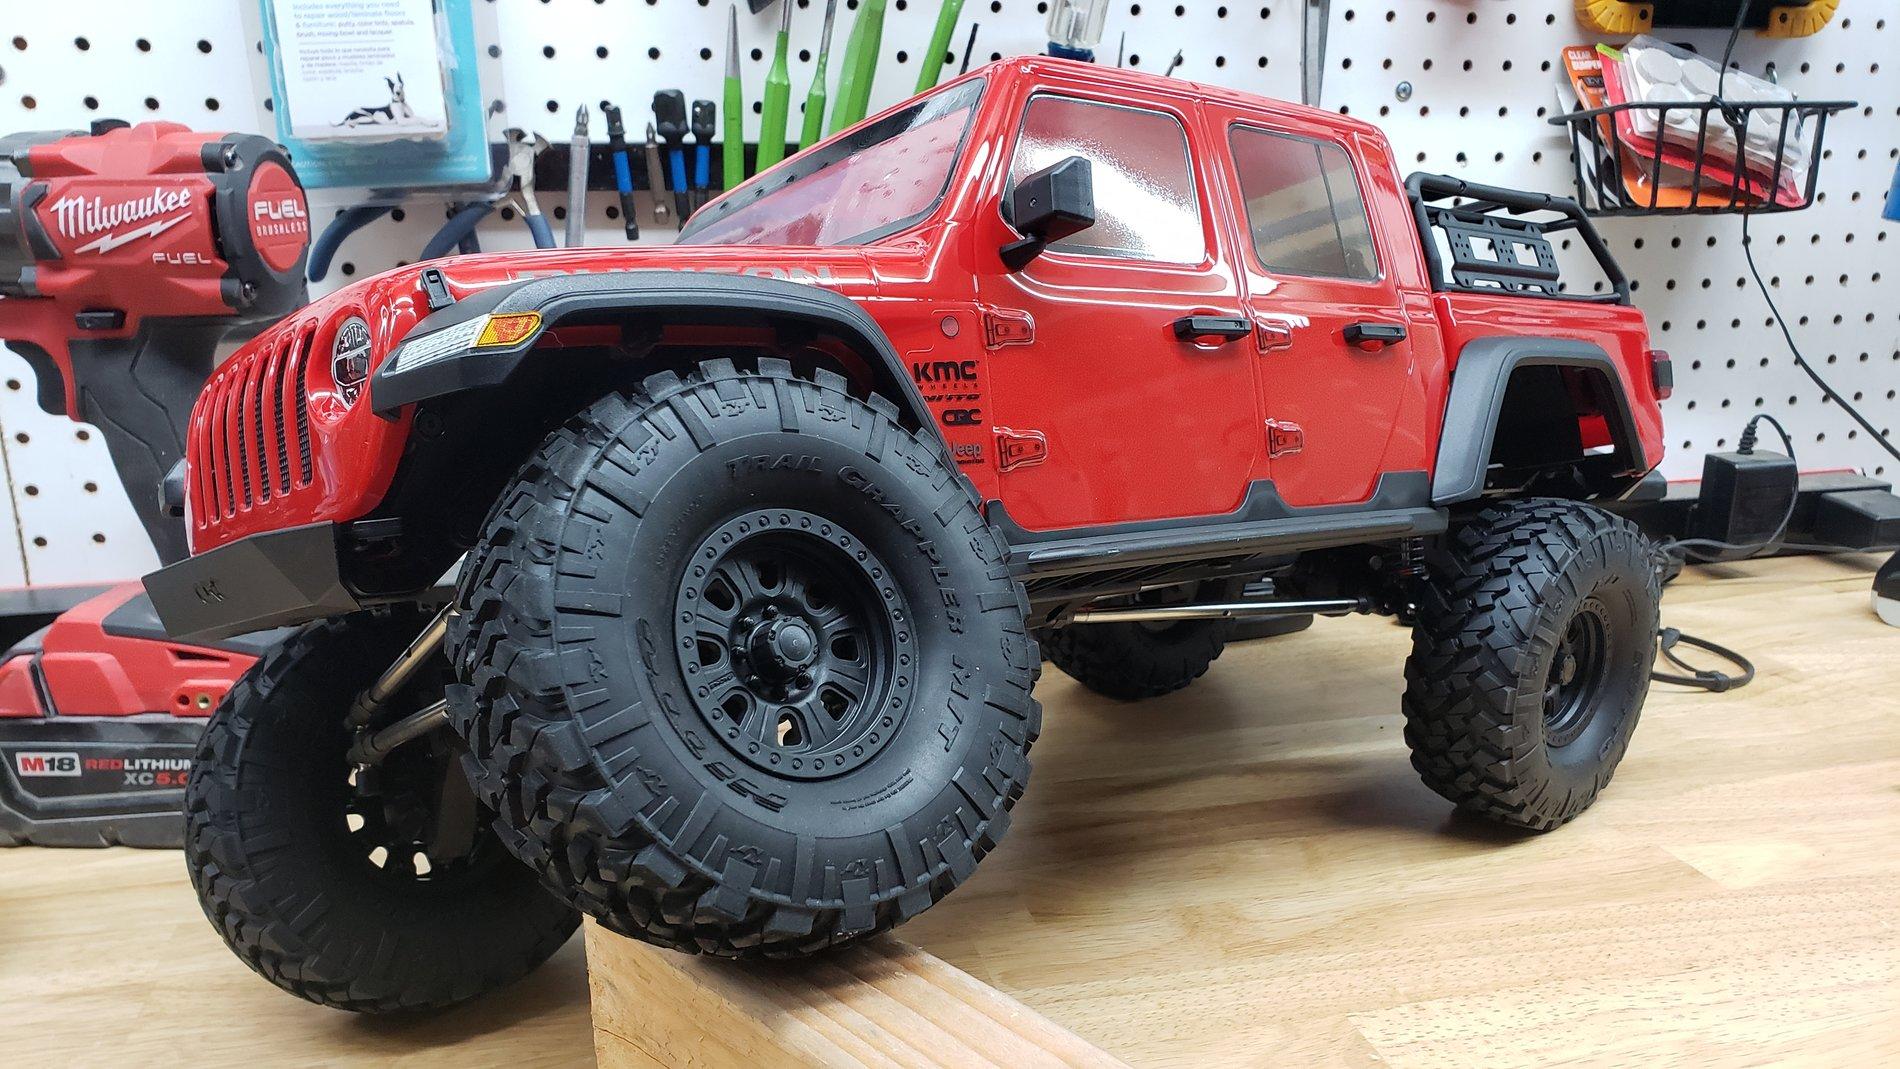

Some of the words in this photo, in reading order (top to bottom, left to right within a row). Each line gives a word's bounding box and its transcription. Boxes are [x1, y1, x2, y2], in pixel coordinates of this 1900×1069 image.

[50, 187, 192, 239] Milwaukee
[254, 199, 307, 219] FUEL
[255, 221, 308, 237] BRUSHLESS
[152, 251, 212, 265] FUEL
[913, 359, 978, 384] KMC
[951, 440, 983, 459] Jeep
[726, 453, 823, 478] TRAIL
[838, 465, 963, 634] GRAPPLER
[938, 653, 971, 753] M/T
[20, 757, 76, 772] M18
